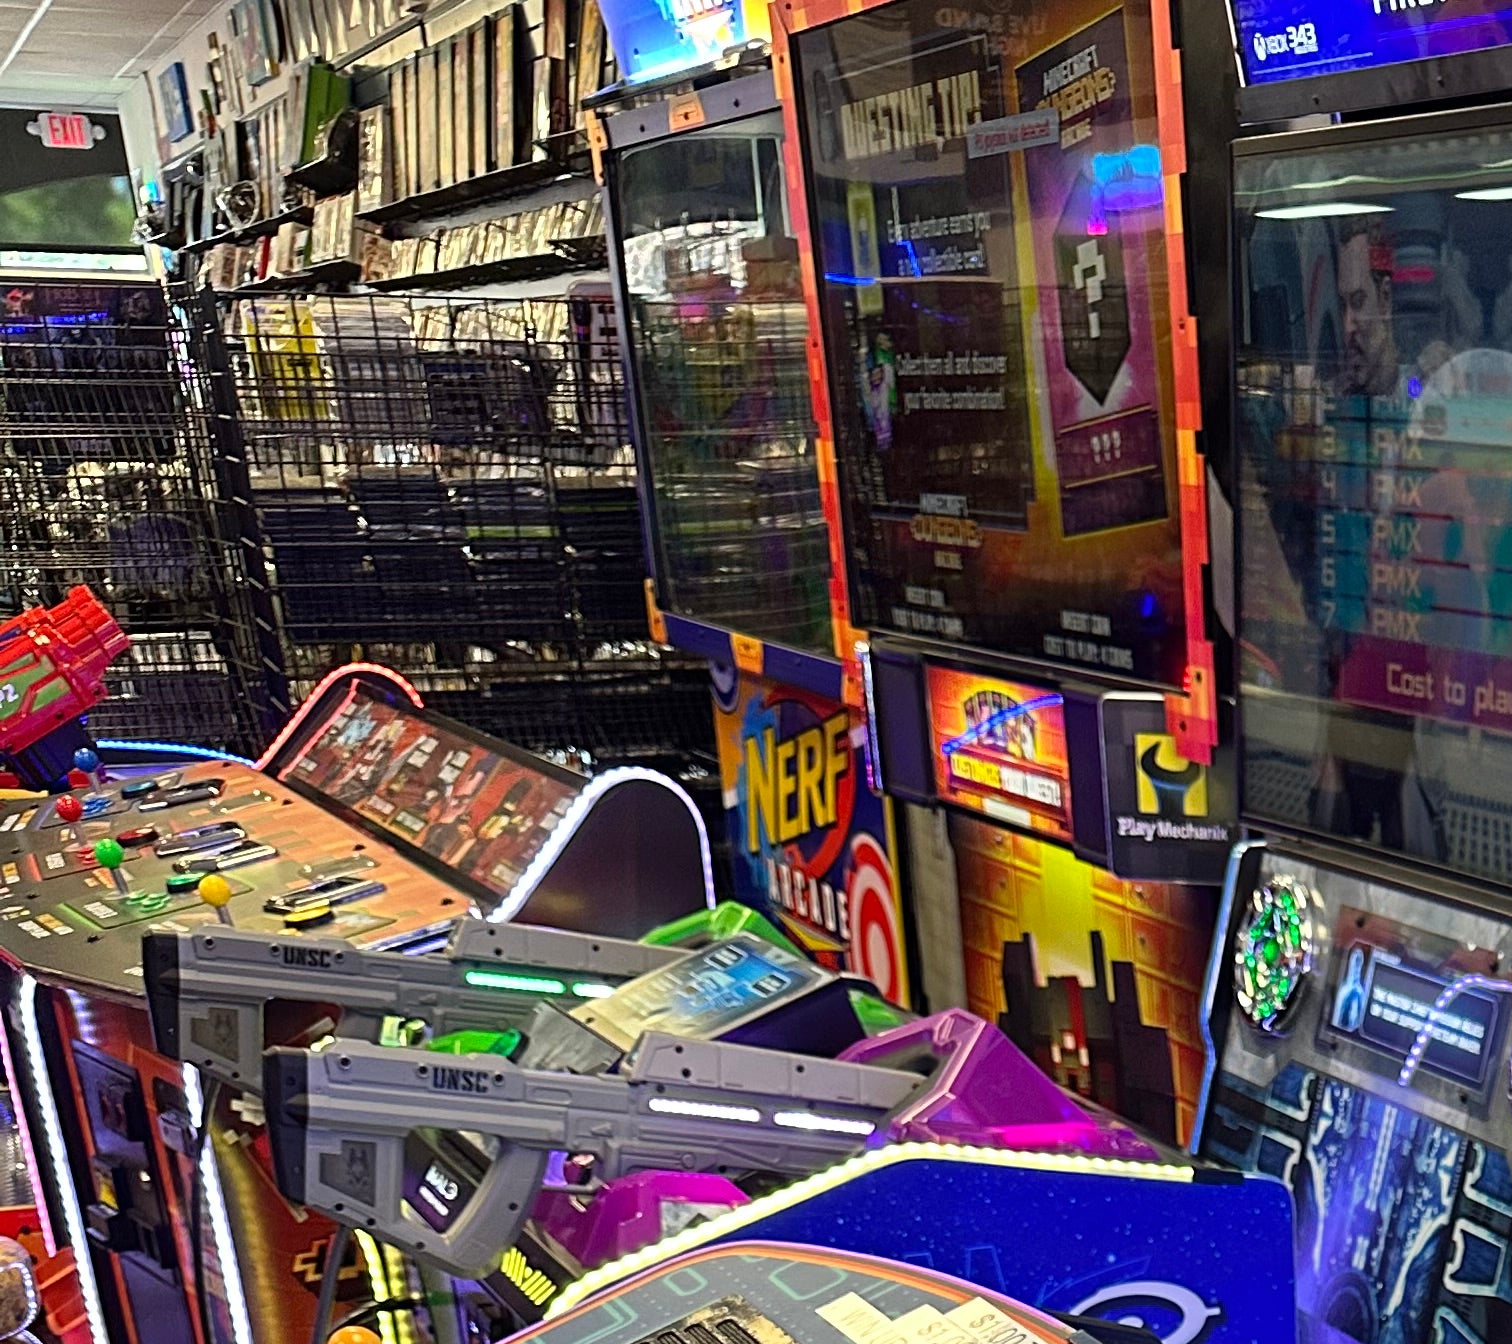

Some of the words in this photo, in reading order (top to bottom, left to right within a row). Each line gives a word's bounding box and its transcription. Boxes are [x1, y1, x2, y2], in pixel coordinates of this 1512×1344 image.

[1286, 23, 1317, 48] 343
[48, 115, 86, 146] EXIT
[1321, 514, 1336, 544] 5
[1373, 518, 1422, 553] PMX
[1321, 558, 1336, 588] 6
[1372, 562, 1421, 599] PMX
[1323, 600, 1336, 628] 7
[1386, 664, 1435, 701] Cost
[1444, 677, 1465, 706] to
[744, 712, 848, 854] NERF
[1116, 816, 1157, 842] Play
[767, 857, 850, 940] ARCADE
[282, 946, 332, 968] UNSC
[432, 1067, 489, 1094] UNSC
[840, 1307, 880, 1343] WIN
